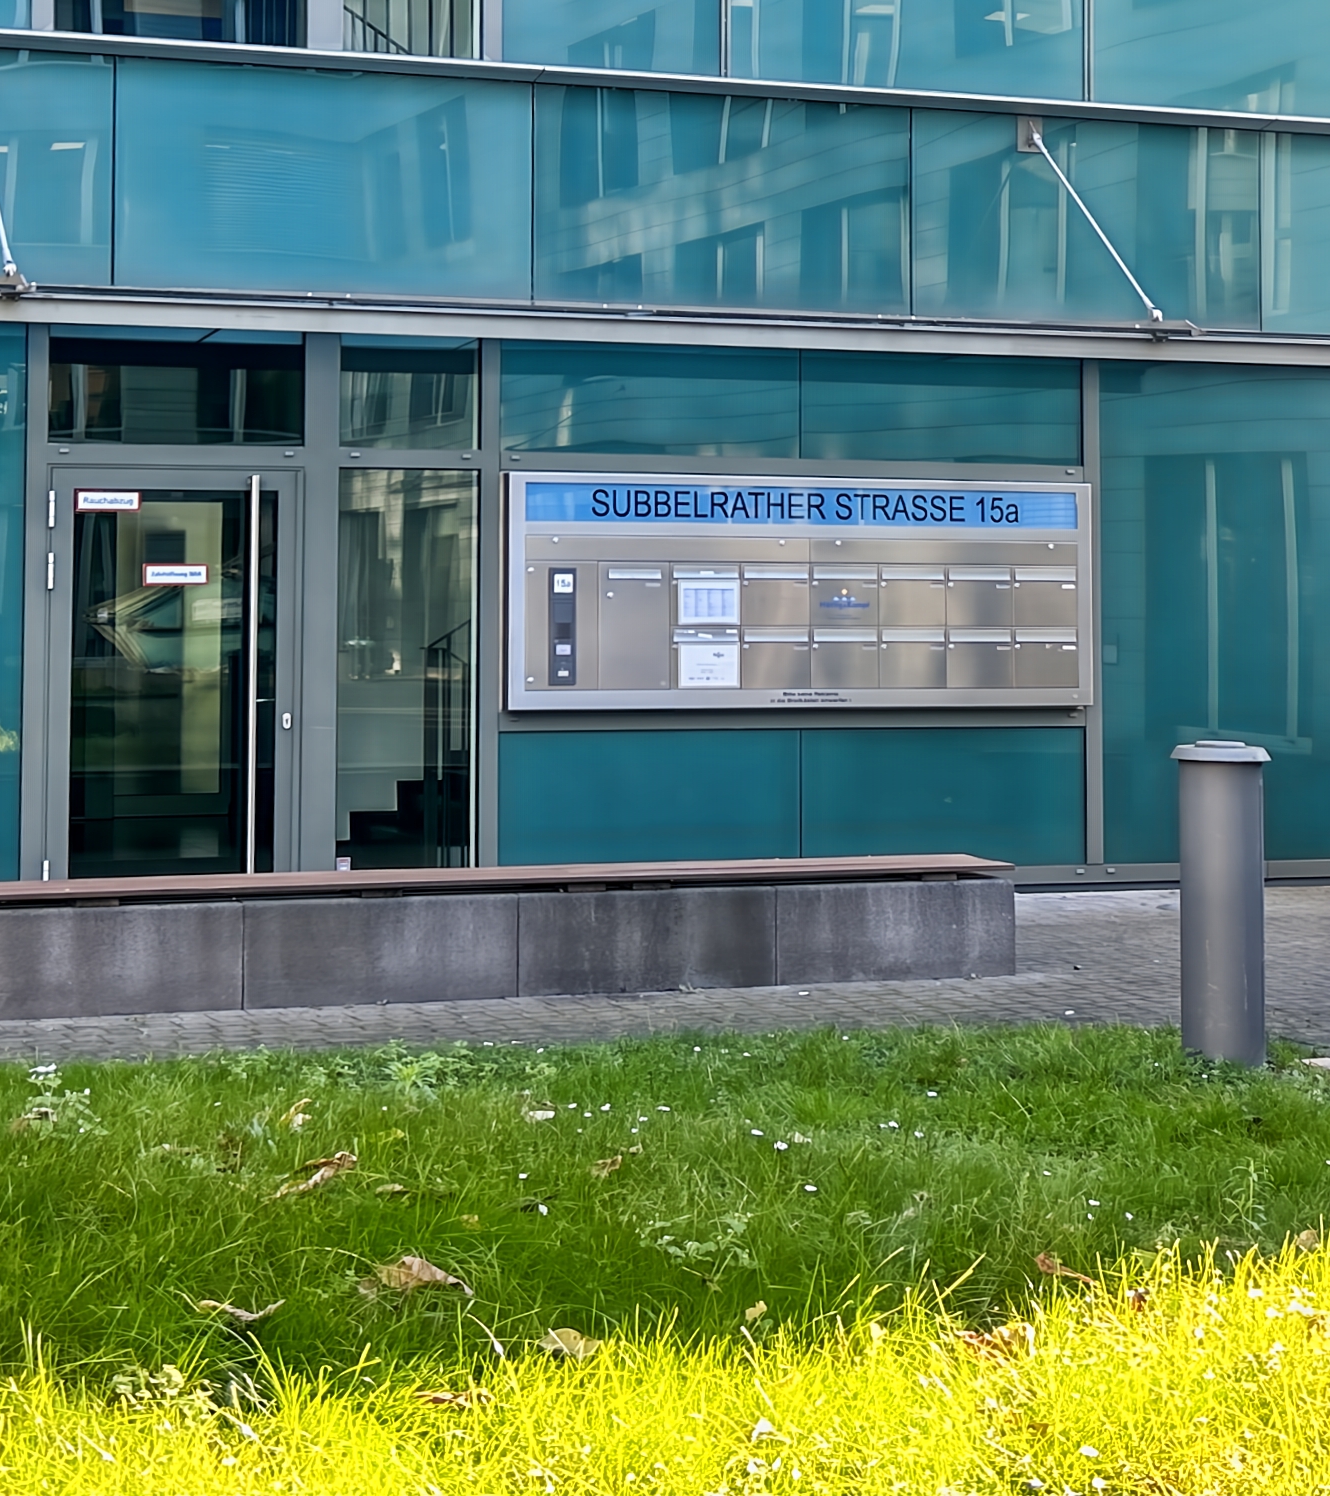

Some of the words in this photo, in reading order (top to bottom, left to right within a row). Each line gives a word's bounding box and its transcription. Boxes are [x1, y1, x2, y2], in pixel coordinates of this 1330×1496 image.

[592, 489, 826, 520] SUBBELRATHER
[835, 493, 965, 522] STRASSE
[976, 497, 1019, 523] 15a
